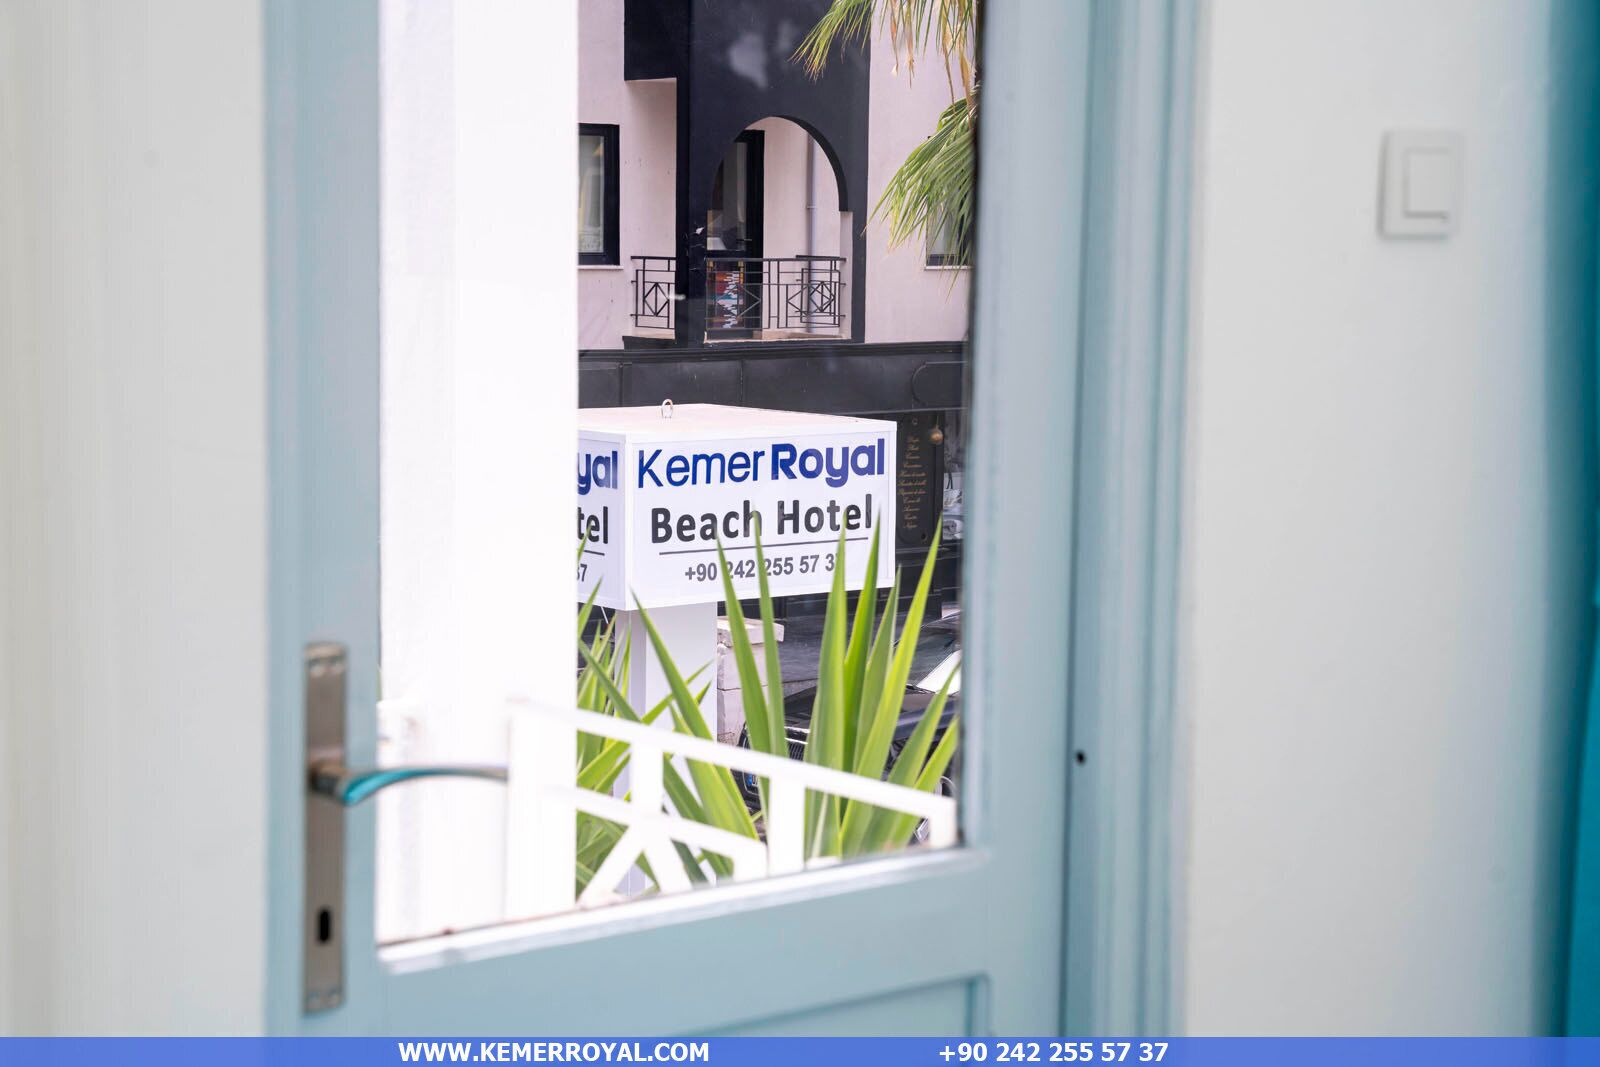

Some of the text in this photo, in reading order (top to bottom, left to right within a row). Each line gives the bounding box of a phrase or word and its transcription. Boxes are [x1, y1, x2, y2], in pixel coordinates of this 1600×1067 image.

[651, 493, 872, 544] Beach Hotel
[685, 562, 718, 582] +90
[800, 555, 820, 574] 57
[825, 553, 839, 572] 3
